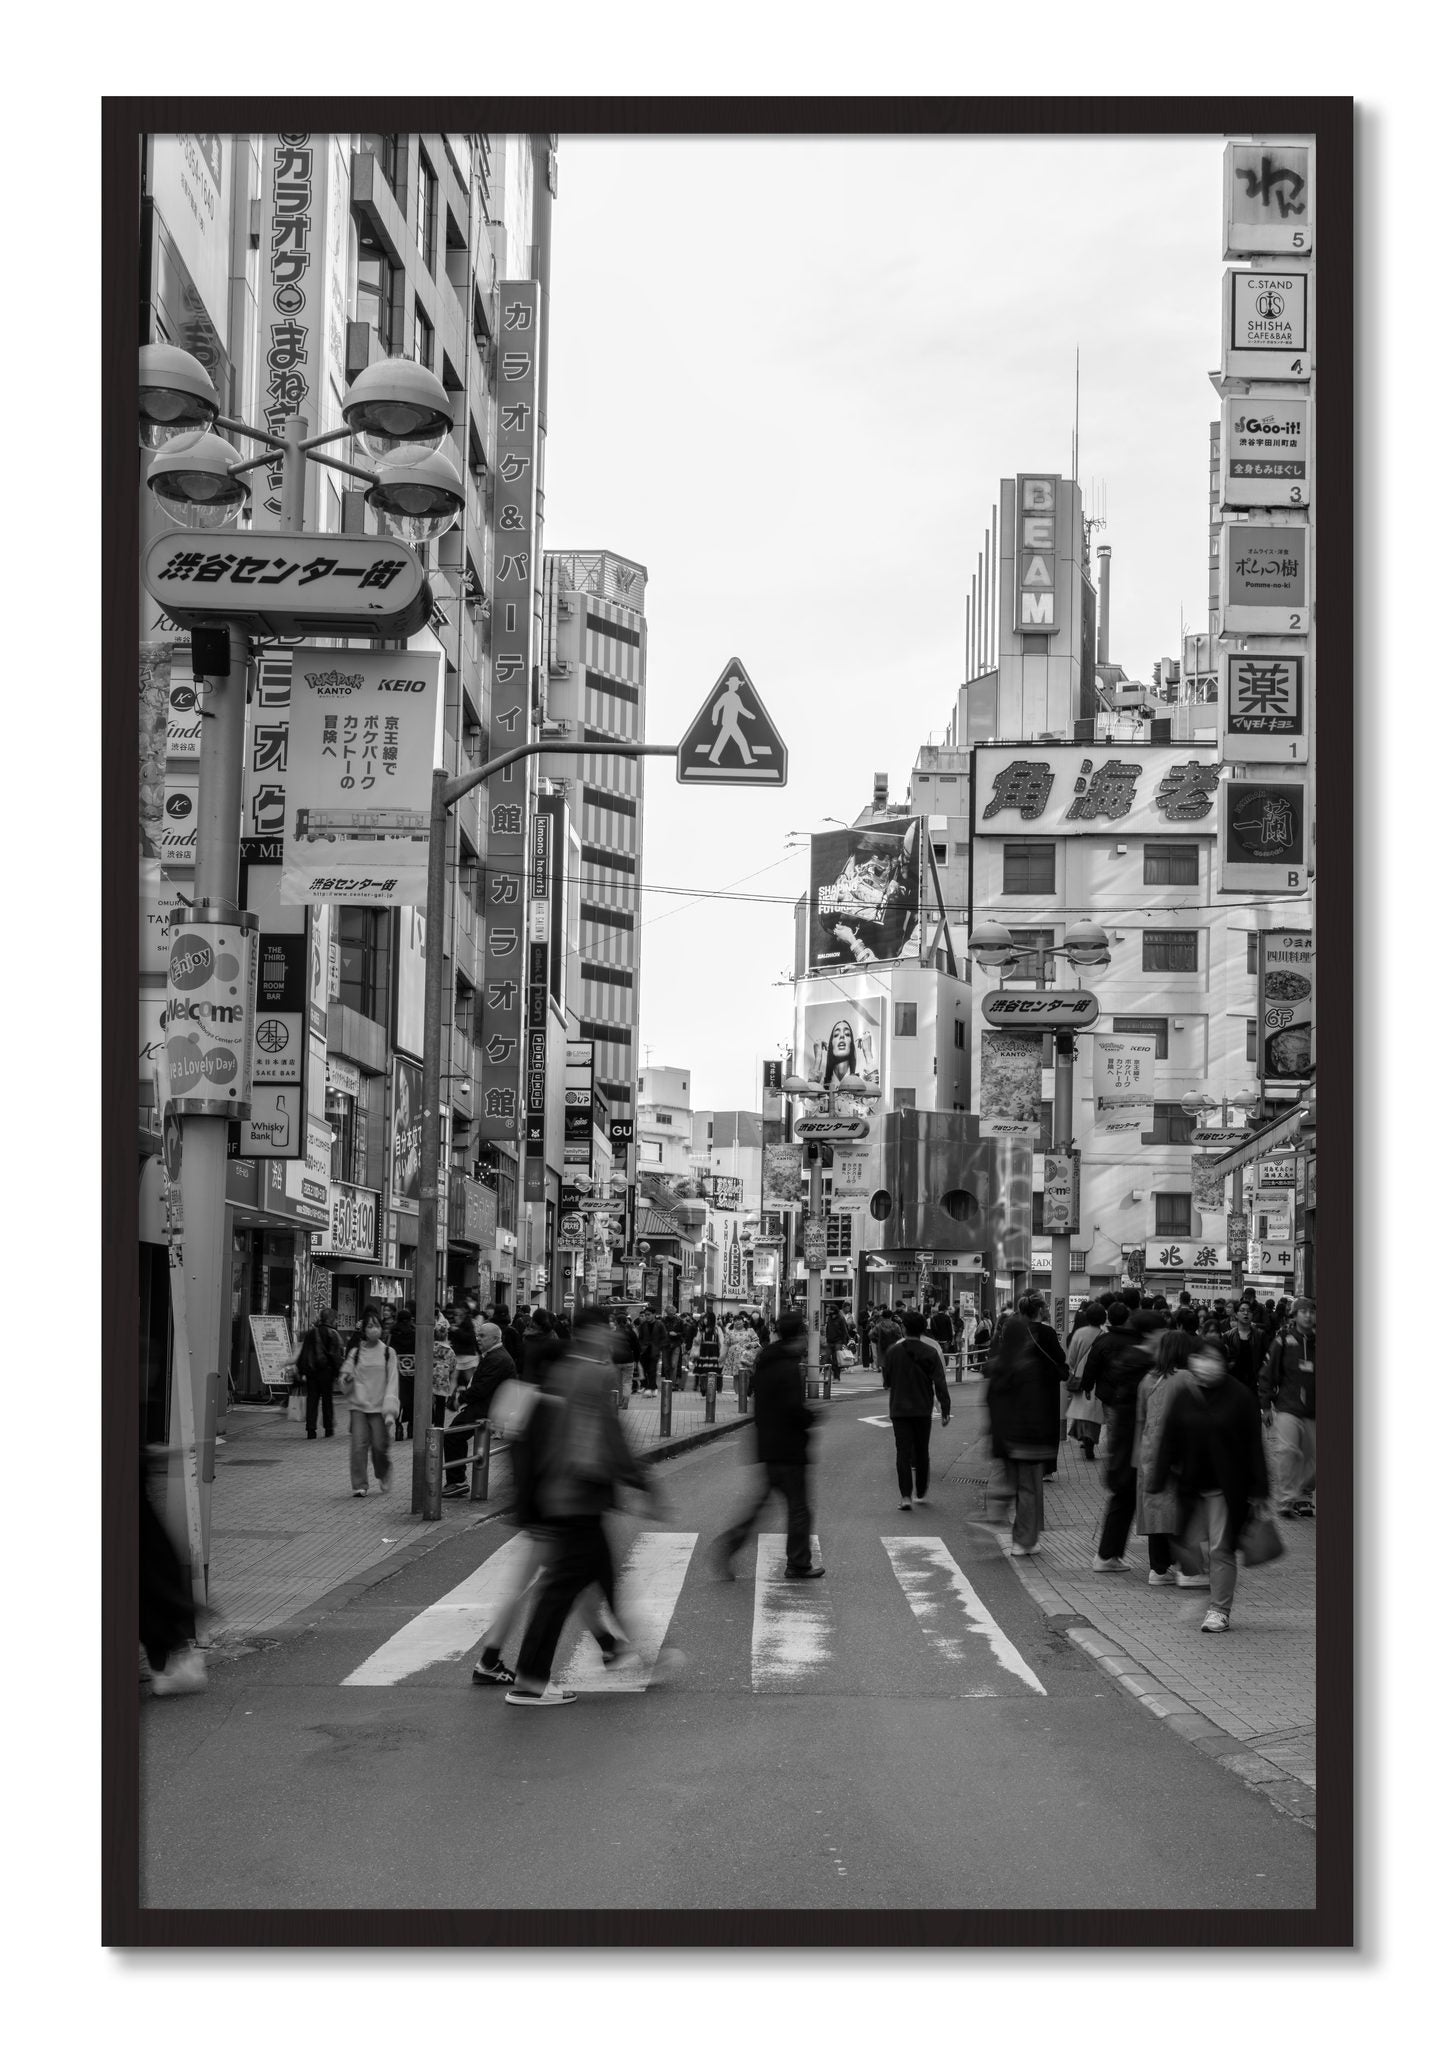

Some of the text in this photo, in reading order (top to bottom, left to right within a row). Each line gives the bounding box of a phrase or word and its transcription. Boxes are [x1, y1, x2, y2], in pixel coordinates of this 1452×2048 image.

[272, 147, 313, 285] カラオケ
[1292, 232, 1304, 247] 5
[1247, 280, 1293, 289] C.STAND
[1247, 321, 1292, 331] SHISHA
[1247, 332, 1292, 340] CAFE&BAR
[1290, 359, 1303, 375] 4
[1246, 418, 1300, 434] Goo-it!
[1239, 438, 1298, 448] 渋谷宇田川町店
[1234, 464, 1302, 475] 全身もみほぐし
[1290, 486, 1302, 503] 3
[1023, 480, 1054, 624] BEAM
[158, 551, 408, 589] 渋谷センター街
[1235, 557, 1299, 577] ポムの樹
[1245, 581, 1291, 589] Pomme-no-ki
[1289, 614, 1301, 629] 2
[317, 687, 352, 695] KANTO
[377, 679, 426, 693] KEIO
[1238, 663, 1289, 713] 薬
[1232, 717, 1294, 731] マツモトキヨシ
[322, 714, 338, 758] 冒険へ
[171, 743, 196, 751] 渋谷店
[340, 715, 358, 790] カントーの
[361, 715, 379, 790] ポケパーク
[382, 716, 400, 775] 京王線で
[1289, 743, 1298, 758] 1
[1233, 799, 1293, 847] 一蘭
[537, 819, 546, 855] kimono
[167, 850, 192, 859] 渋谷店
[309, 878, 398, 891] 渋谷センター街
[1287, 871, 1299, 887] B
[1267, 950, 1310, 964] 四川料理
[171, 948, 211, 982] Enjoy
[167, 998, 243, 1023] Welcome
[989, 999, 1093, 1013] 渋谷センター街
[1265, 1008, 1294, 1028] 6F
[184, 1056, 214, 1078] Lovely
[216, 1057, 236, 1071] Day!
[251, 1122, 284, 1133] Whisky
[612, 1126, 632, 1136] GU
[798, 1122, 859, 1132] 渋谷センター街
[250, 1132, 271, 1140] Bank
[227, 1142, 238, 1153] 1F
[731, 1244, 740, 1286] BEER
